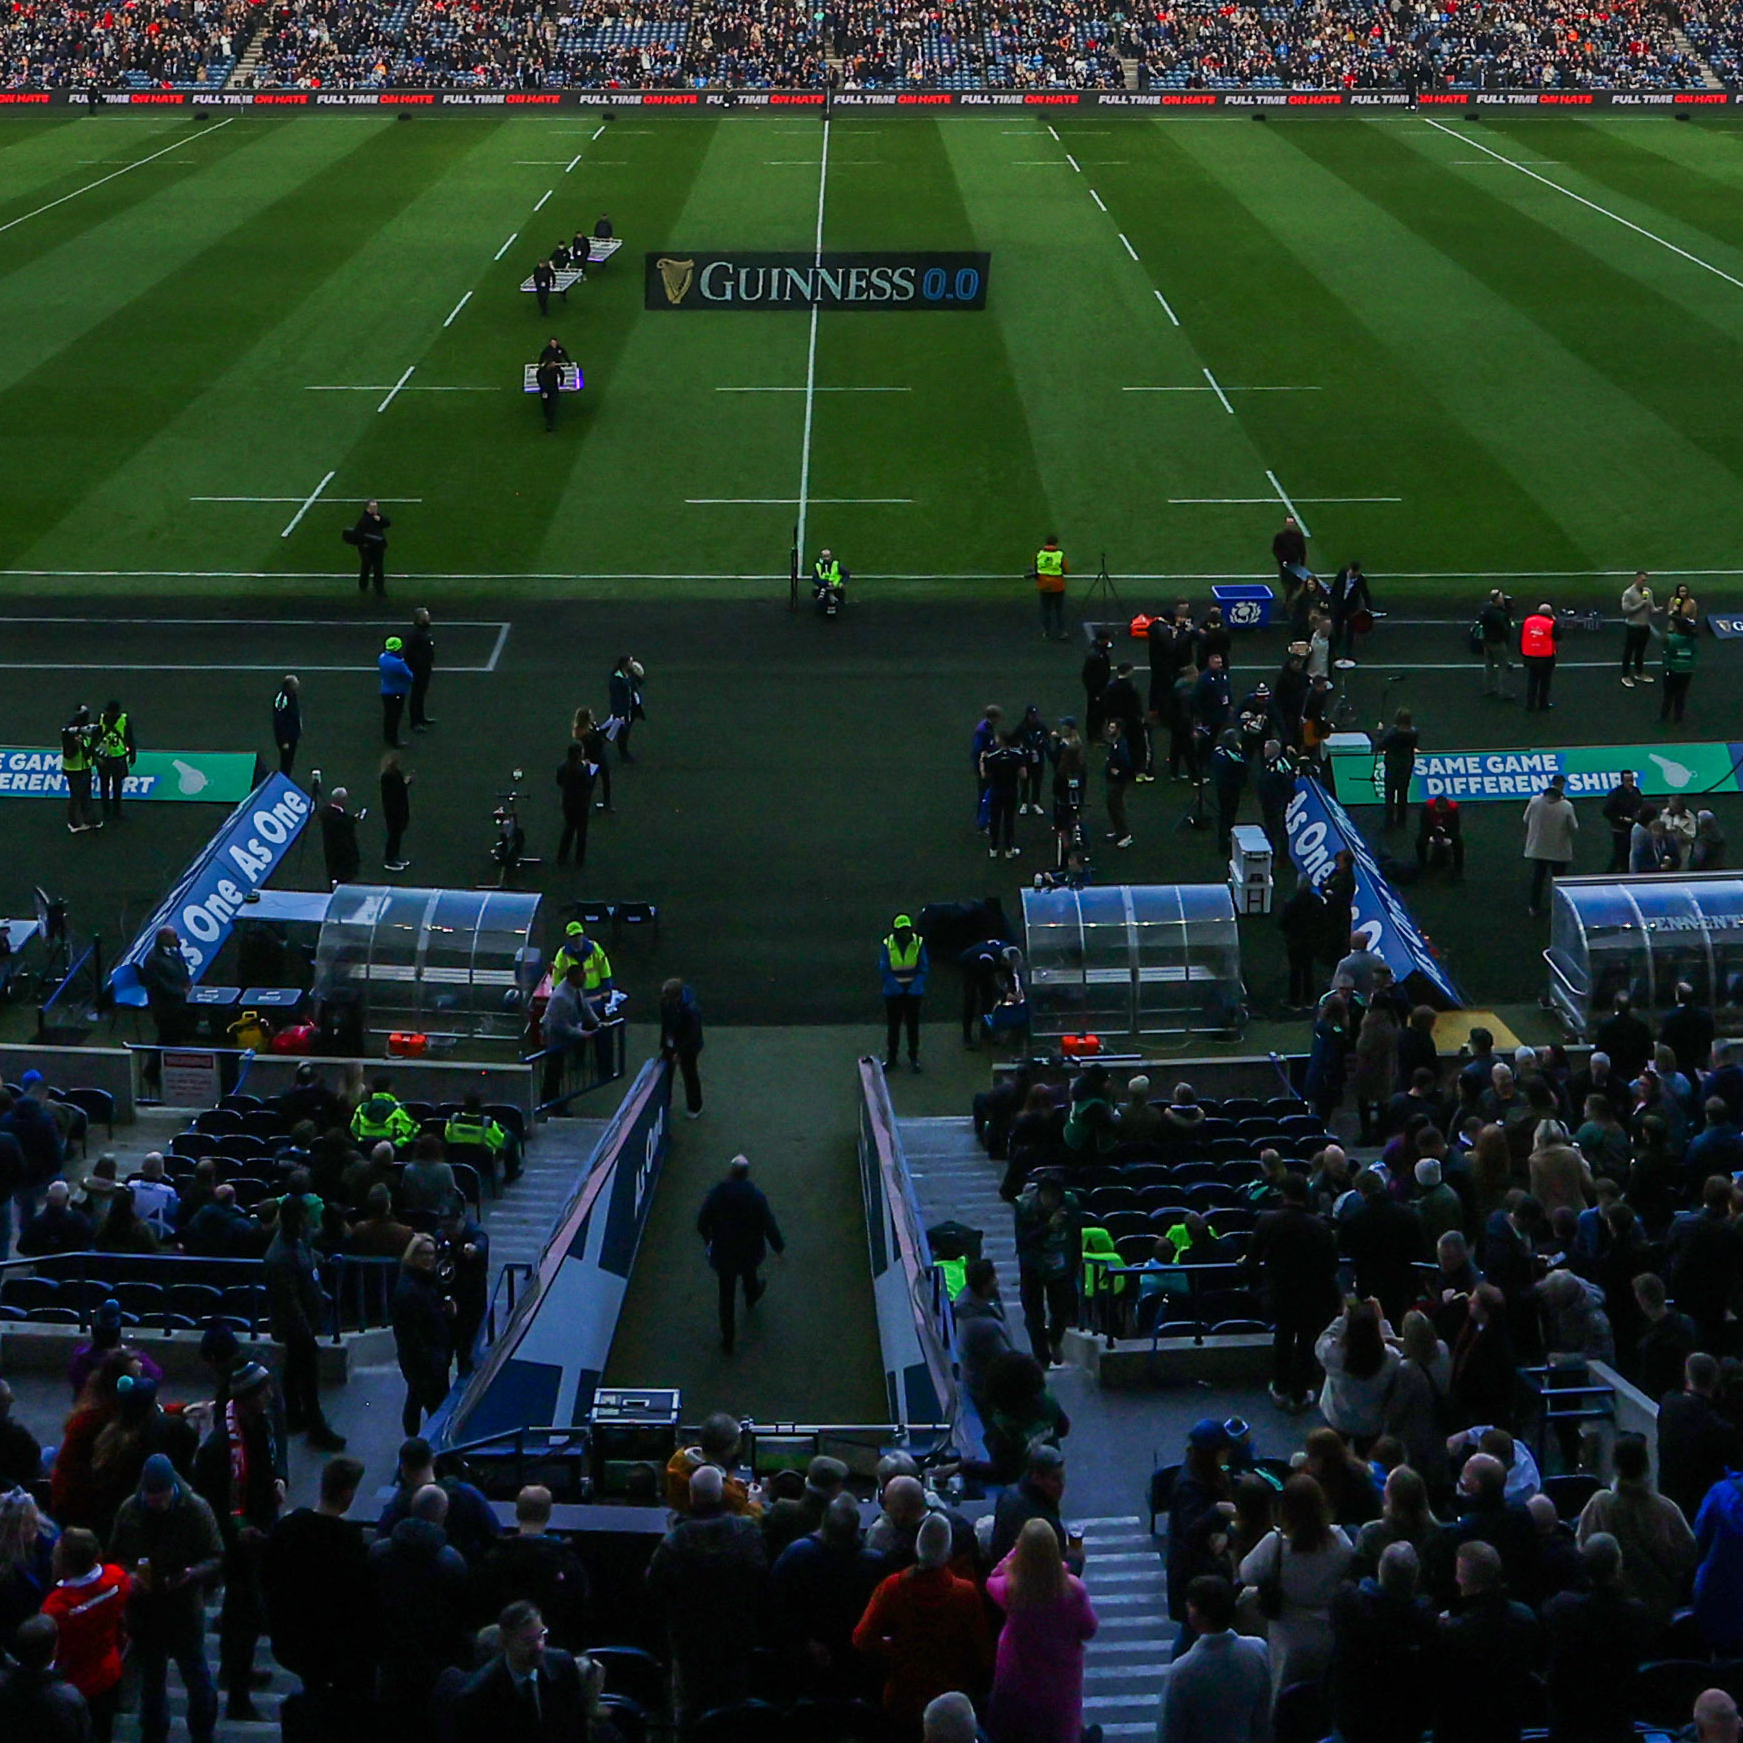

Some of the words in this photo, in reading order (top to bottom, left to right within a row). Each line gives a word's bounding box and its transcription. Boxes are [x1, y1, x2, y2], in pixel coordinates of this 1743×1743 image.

[317, 95, 346, 105] FULL
[348, 95, 378, 105] TIME
[380, 95, 399, 105] ON
[400, 95, 434, 105] HATE
[961, 95, 990, 105] FULL
[992, 95, 1023, 105] TIME
[1025, 95, 1044, 105] ON
[1045, 95, 1079, 105] HATE
[1612, 95, 1641, 105] FULL
[1643, 95, 1673, 105] TIME
[1675, 95, 1693, 105] ON
[1694, 95, 1727, 105] HATE
[699, 261, 916, 302] GUINNESS
[921, 267, 978, 300] 0.0
[9, 753, 63, 771] GAM
[1414, 756, 1482, 776] SAME
[1486, 754, 1559, 774] GAME
[228, 838, 273, 883] As
[253, 791, 307, 844] One
[1295, 821, 1337, 887] One
[183, 879, 243, 942] One
